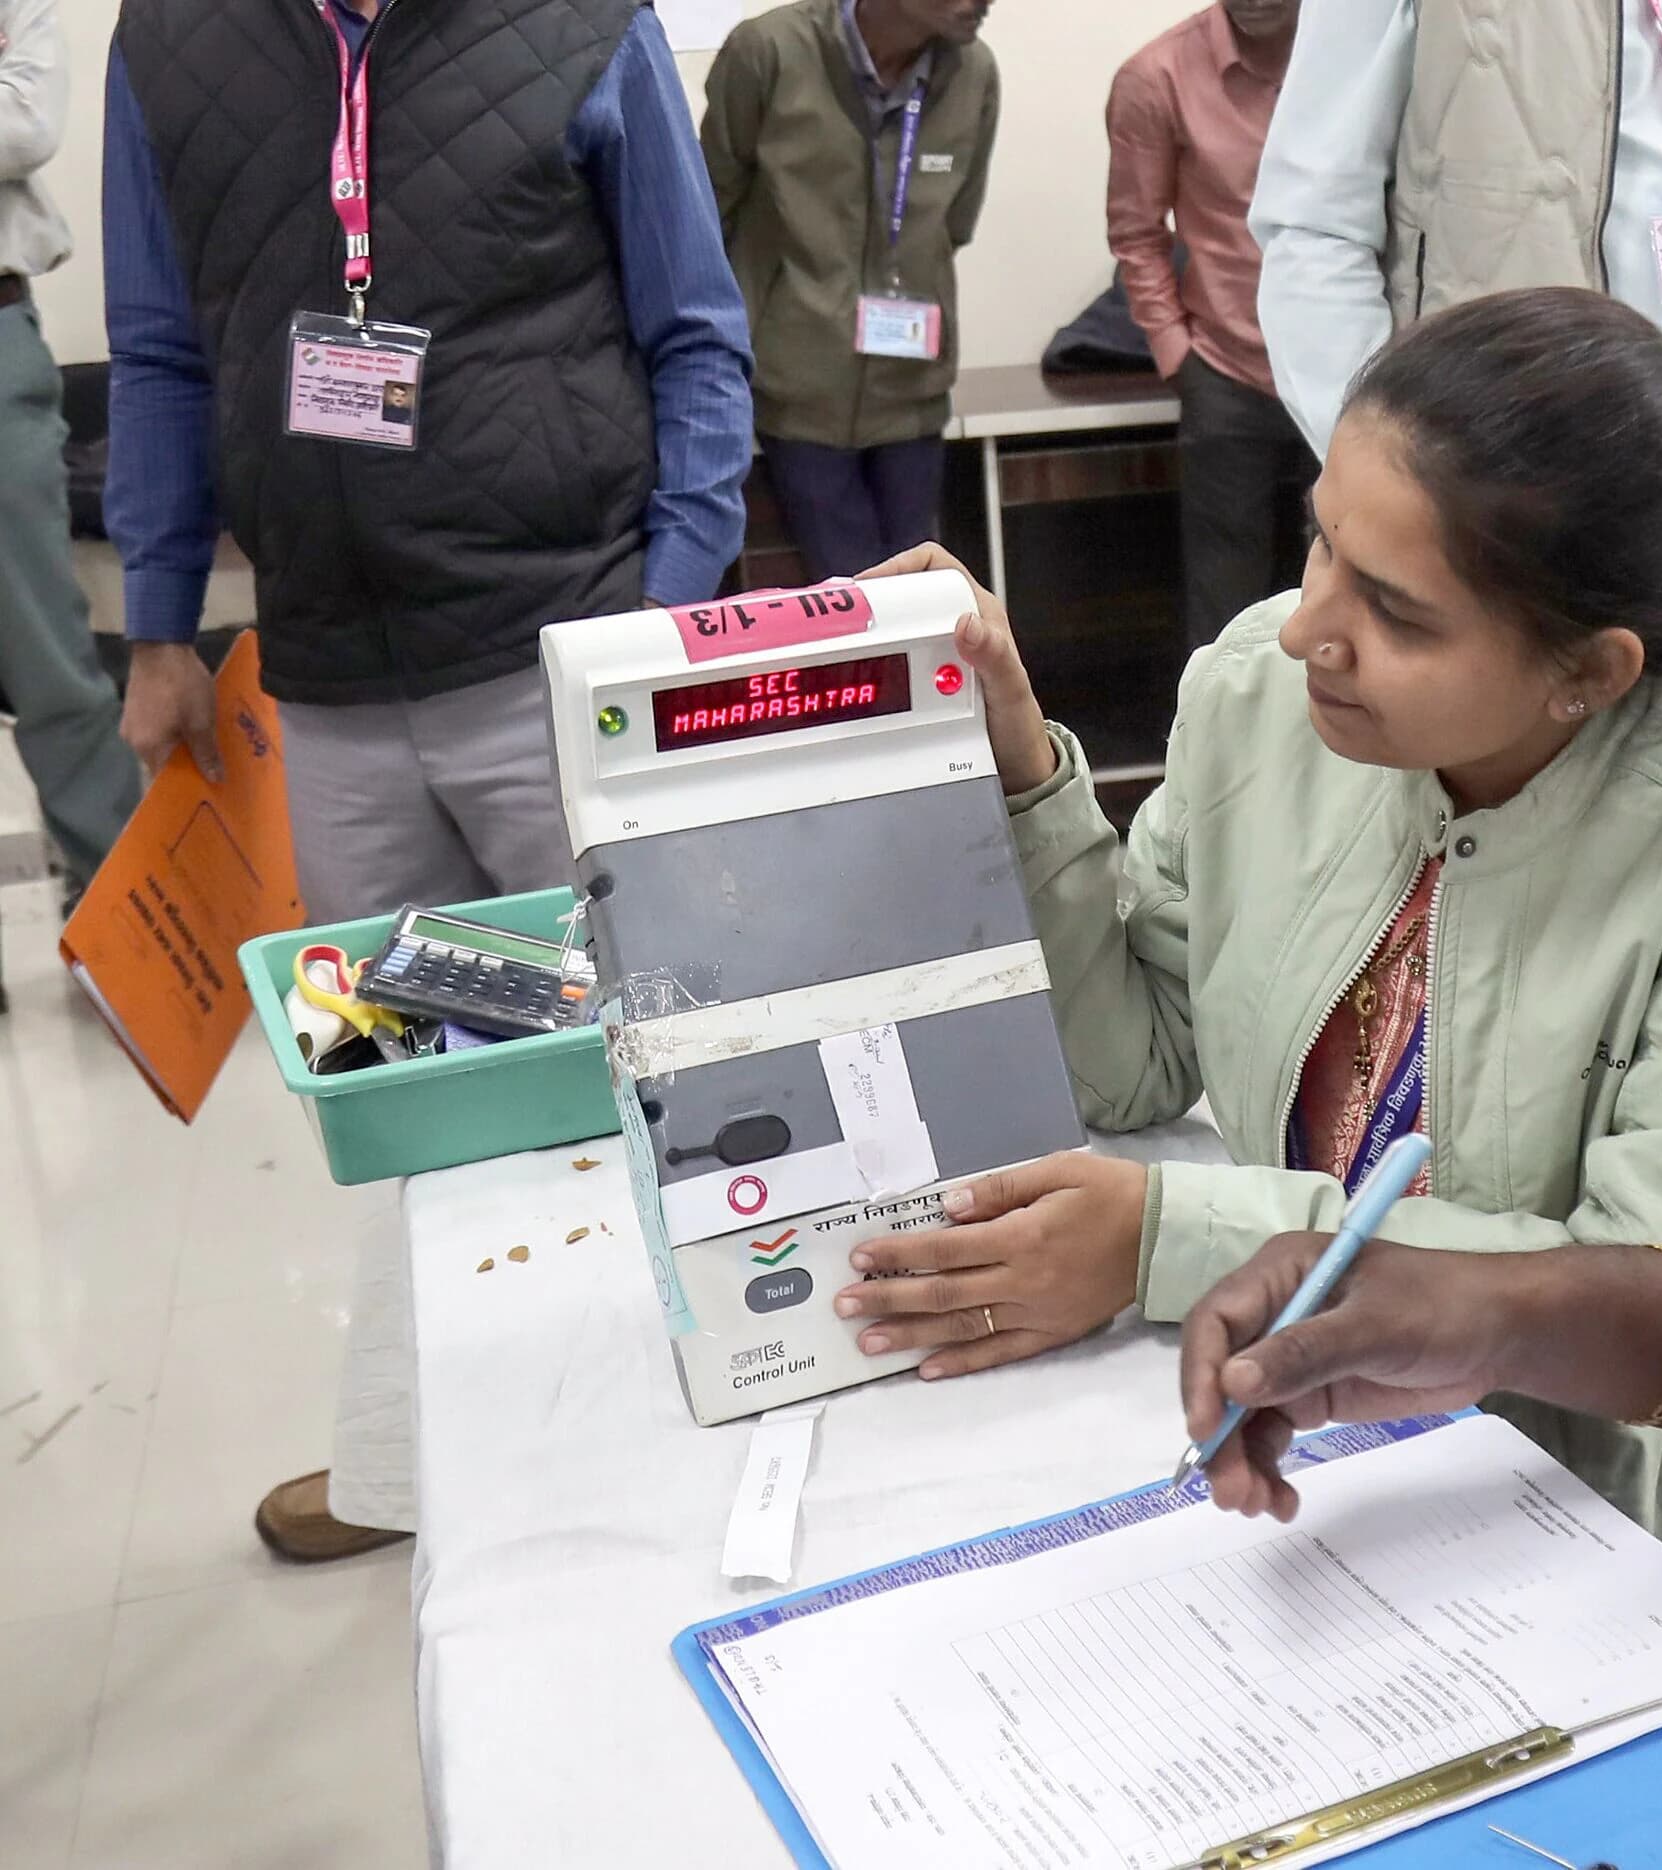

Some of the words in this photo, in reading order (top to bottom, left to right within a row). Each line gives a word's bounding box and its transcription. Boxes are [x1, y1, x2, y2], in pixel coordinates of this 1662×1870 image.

[689, 604, 757, 637] 1/3
[748, 670, 800, 699] SEC
[673, 683, 876, 734] MAHARASHTRA
[948, 760, 974, 773] Busy
[622, 818, 640, 831] On
[812, 1212, 858, 1234] राज्य
[764, 1282, 795, 1301] Total
[732, 1366, 784, 1390] Control
[788, 1356, 816, 1376] Unit
